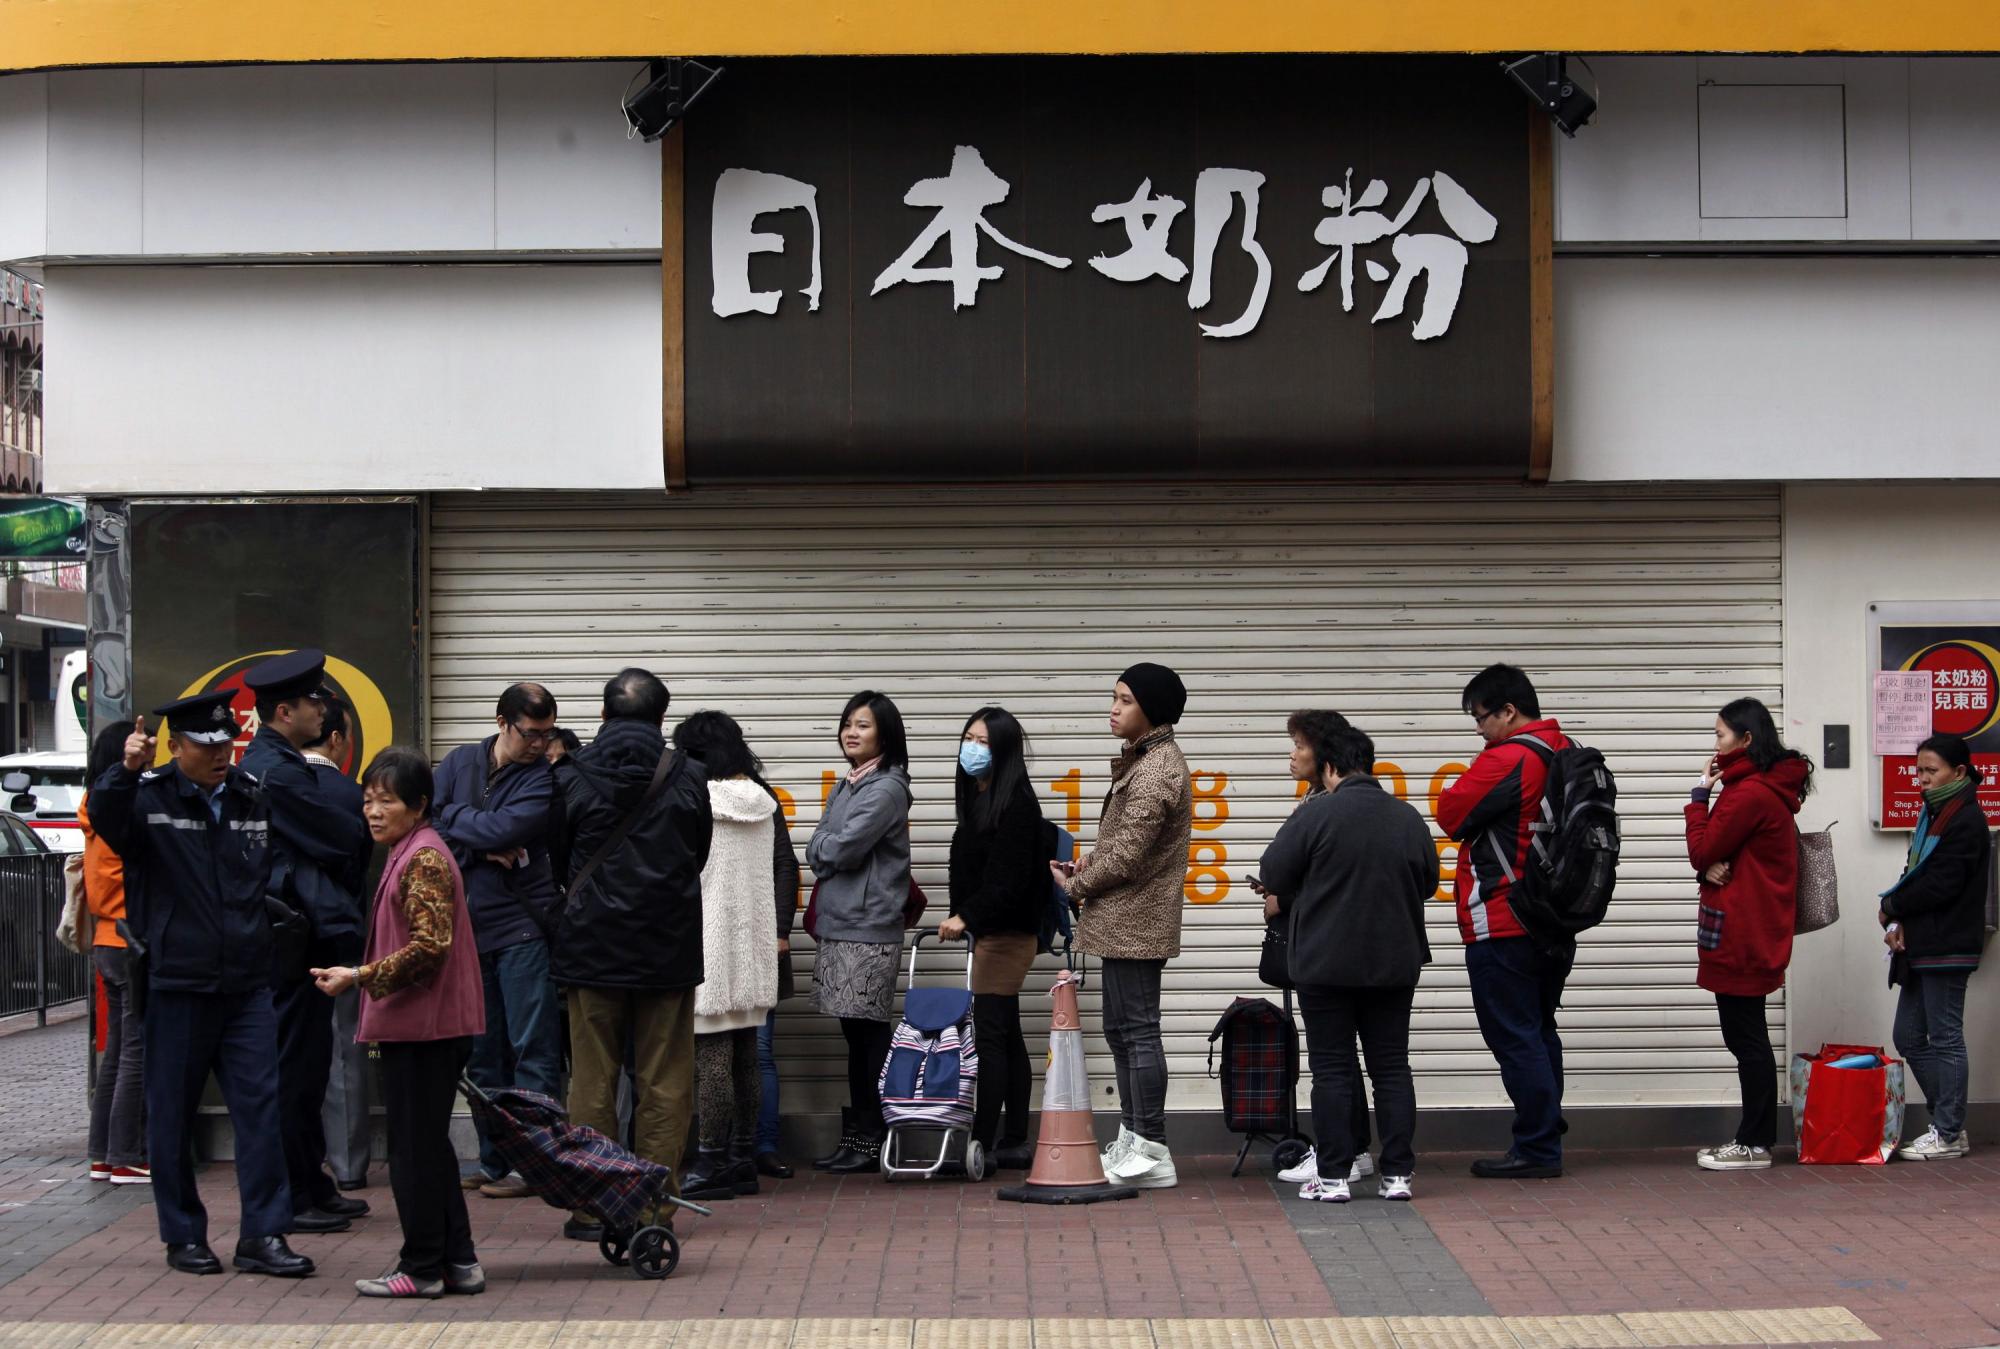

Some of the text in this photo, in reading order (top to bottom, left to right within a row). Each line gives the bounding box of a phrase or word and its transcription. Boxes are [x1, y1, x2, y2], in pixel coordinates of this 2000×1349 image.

[712, 145, 1498, 340] 日本奶粉
[1894, 801, 1913, 809] Shop
